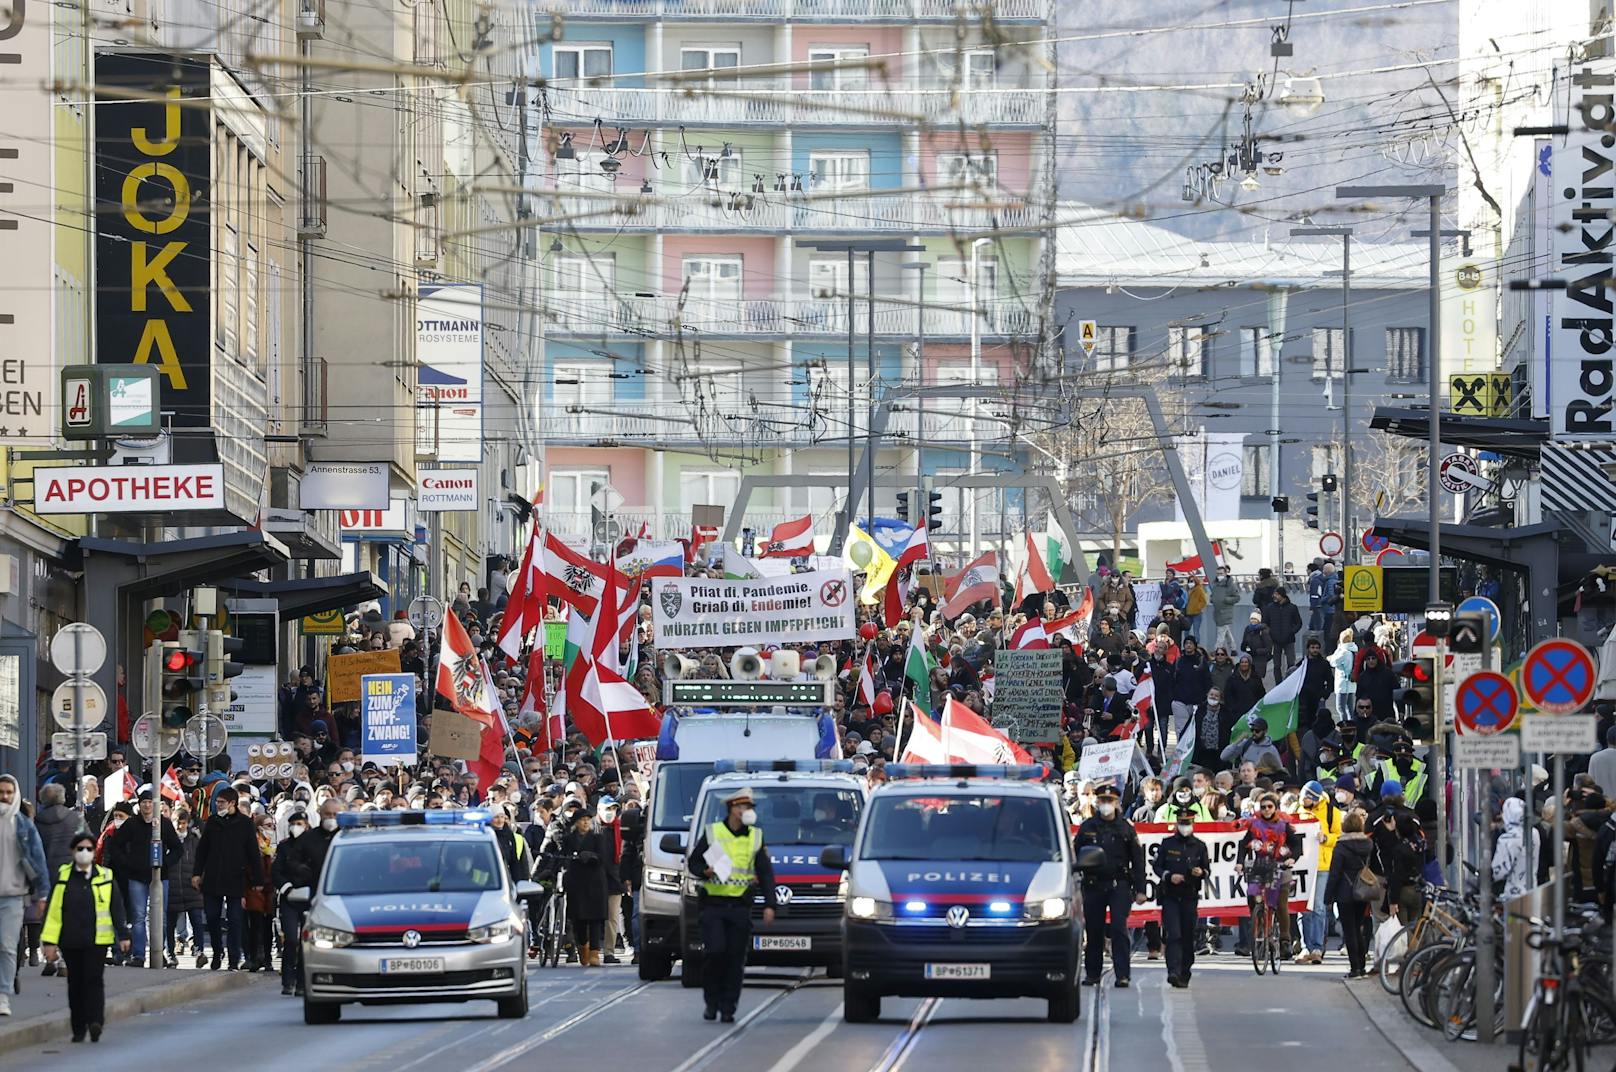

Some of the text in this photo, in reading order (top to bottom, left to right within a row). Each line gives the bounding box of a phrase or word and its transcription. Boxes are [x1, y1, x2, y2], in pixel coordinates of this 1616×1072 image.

[121, 85, 193, 390] JOKA
[0, 360, 24, 384] EI
[0, 391, 42, 416] EN
[310, 466, 367, 474] Annenstrasse
[1212, 465, 1240, 479] DANIEL
[44, 476, 214, 502] APOTHEKE
[422, 478, 472, 489] Canon
[422, 494, 472, 502] ROTTMANN
[690, 586, 720, 598] Pfiat
[742, 583, 812, 598] Pandemie.
[692, 602, 728, 614] Griaß
[752, 596, 812, 612] Endemie!
[662, 622, 720, 637] MÜRZTAL
[722, 620, 762, 635] GEGEN
[368, 680, 392, 695] NEIN
[368, 696, 392, 710] ZUM
[368, 711, 400, 726] IMPF-
[368, 725, 410, 741] ZWANG!
[770, 856, 818, 864] LIZE
[908, 872, 1010, 883] POLIZEI
[370, 904, 453, 912] POLIZEI
